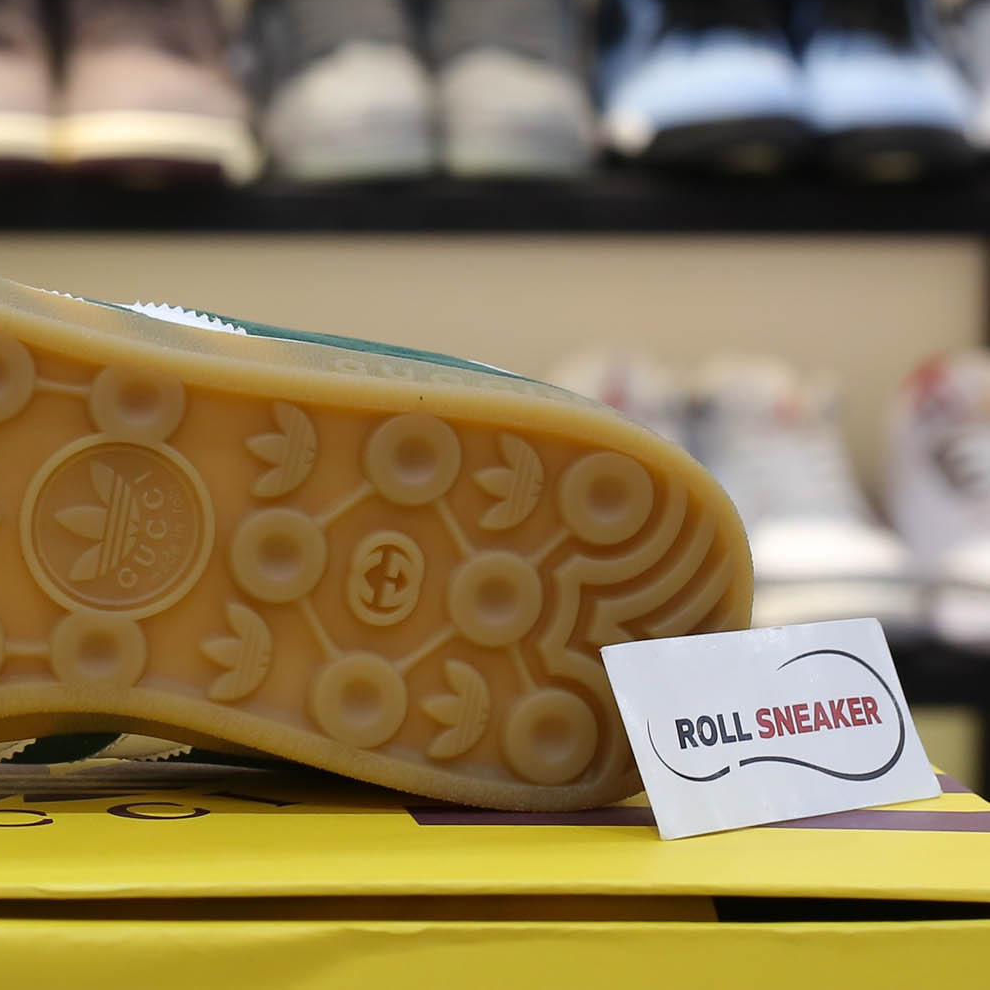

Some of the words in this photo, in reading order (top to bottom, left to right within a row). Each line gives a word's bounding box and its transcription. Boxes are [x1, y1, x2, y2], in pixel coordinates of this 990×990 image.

[117, 471, 165, 589] GUCCI
[675, 712, 753, 750] ROLL
[754, 695, 883, 739] SNEAKER
